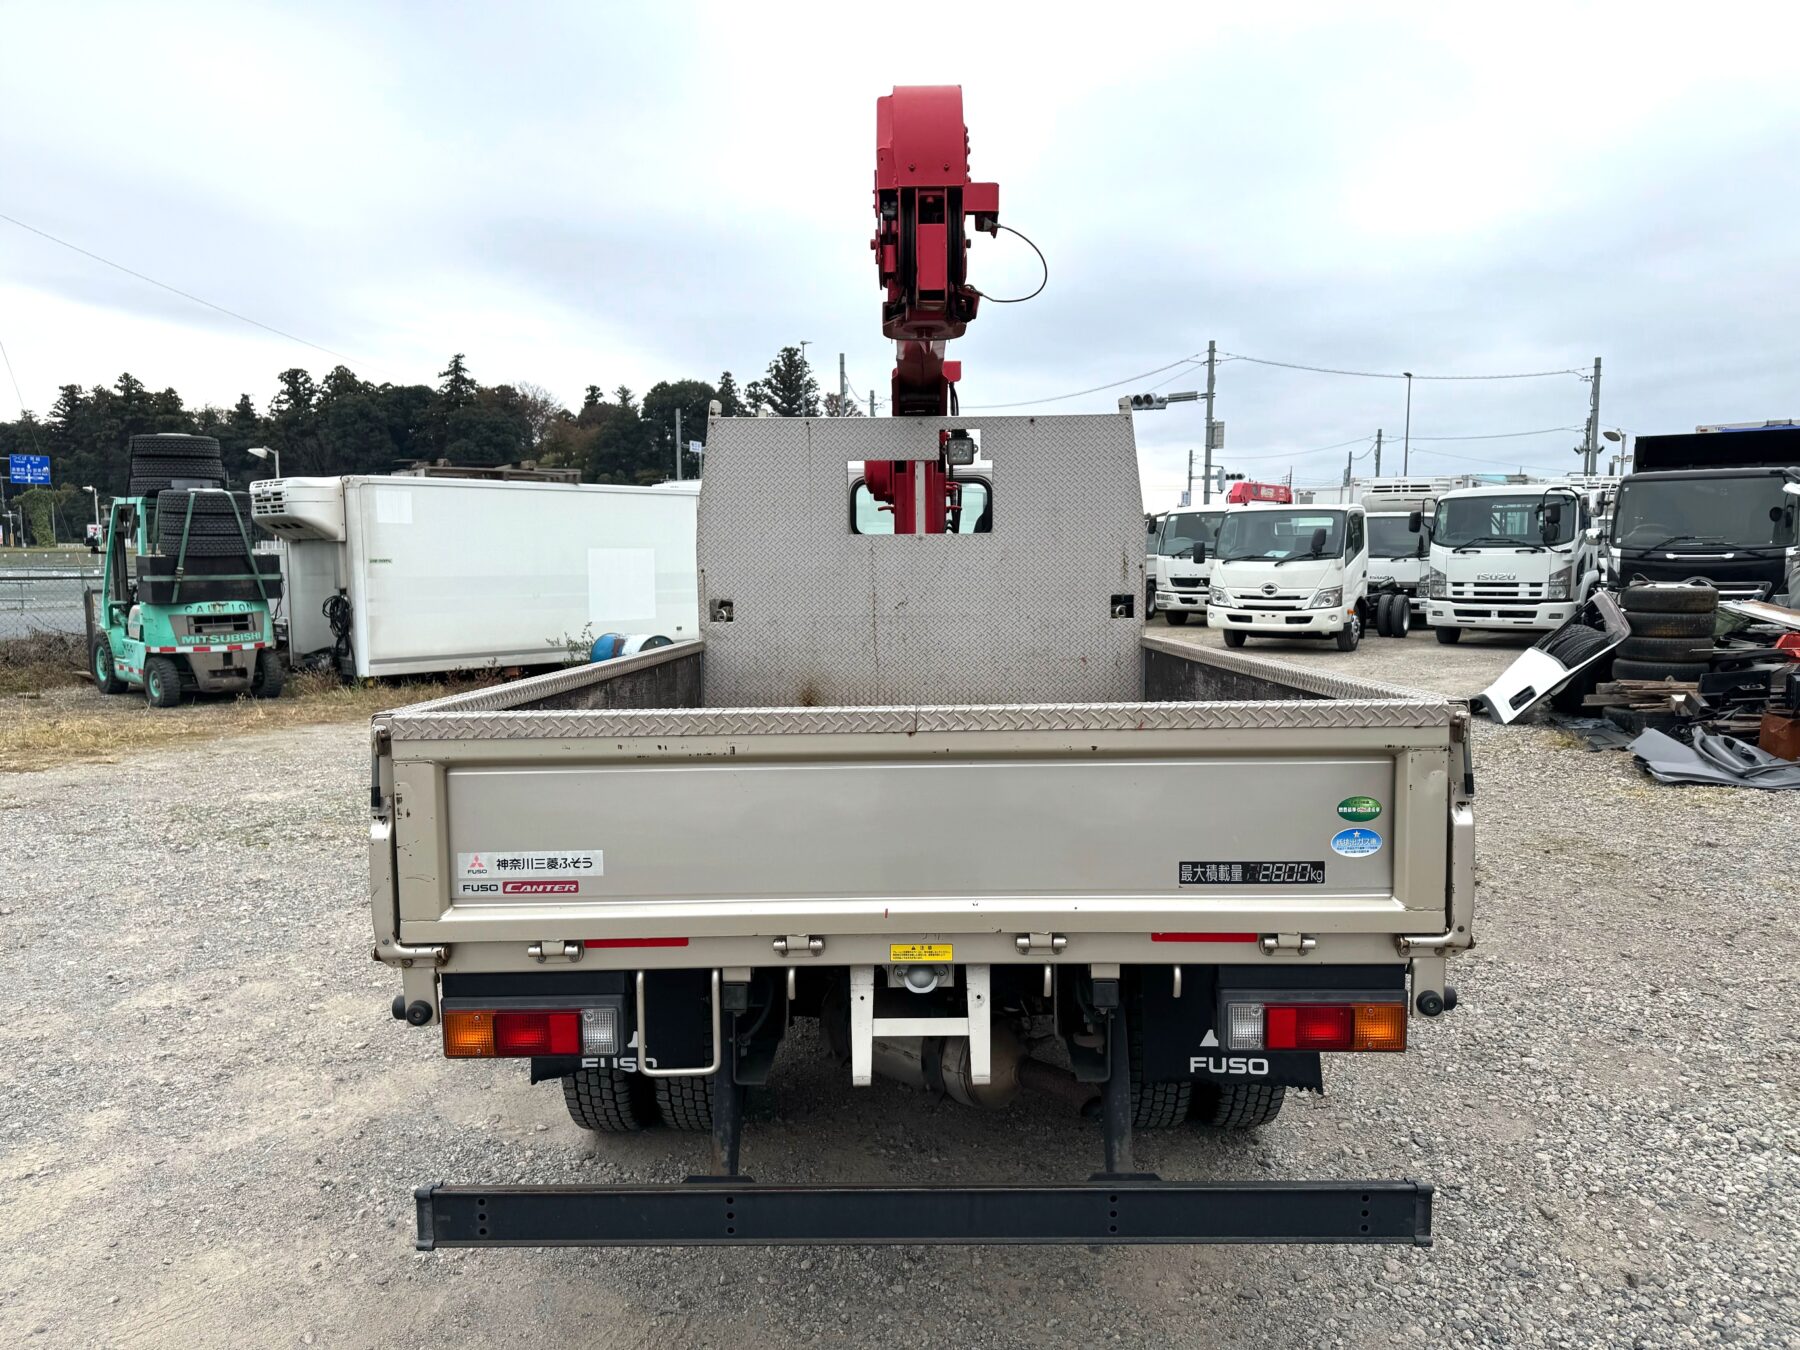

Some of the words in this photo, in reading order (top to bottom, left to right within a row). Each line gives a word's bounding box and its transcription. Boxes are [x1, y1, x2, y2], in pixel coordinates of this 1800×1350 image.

[1476, 572, 1516, 581] ISUZU
[184, 602, 253, 613] CAUTION
[181, 632, 261, 645] MITSUBISHI
[496, 857, 593, 871] 神奈川三菱ふそう
[1180, 864, 1243, 882] 最大積載量
[462, 884, 499, 893] FUSO
[504, 883, 577, 893] CANTER
[1189, 1057, 1269, 1075] FUSO
